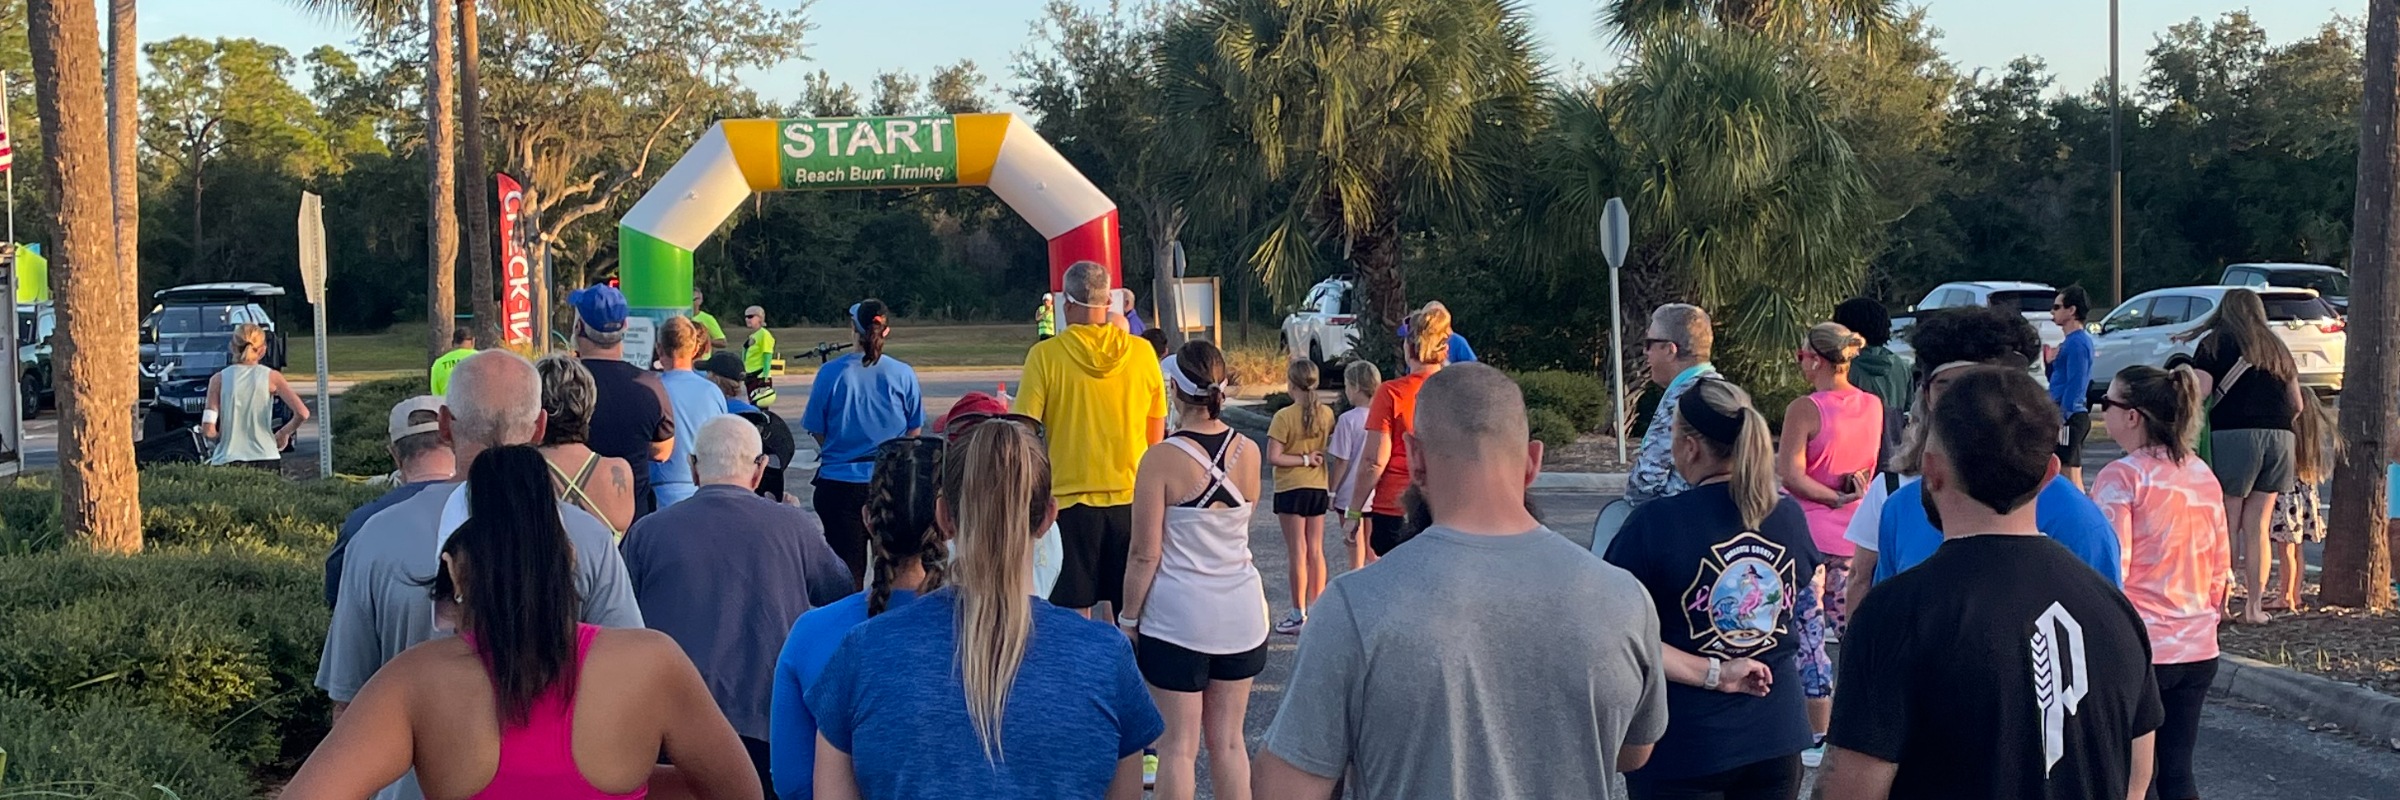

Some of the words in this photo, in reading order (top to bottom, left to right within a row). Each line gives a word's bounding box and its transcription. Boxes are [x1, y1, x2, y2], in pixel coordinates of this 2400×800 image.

[783, 118, 952, 159] START
[795, 167, 845, 184] Beach
[850, 165, 886, 182] Bum
[891, 162, 945, 181] Timing
